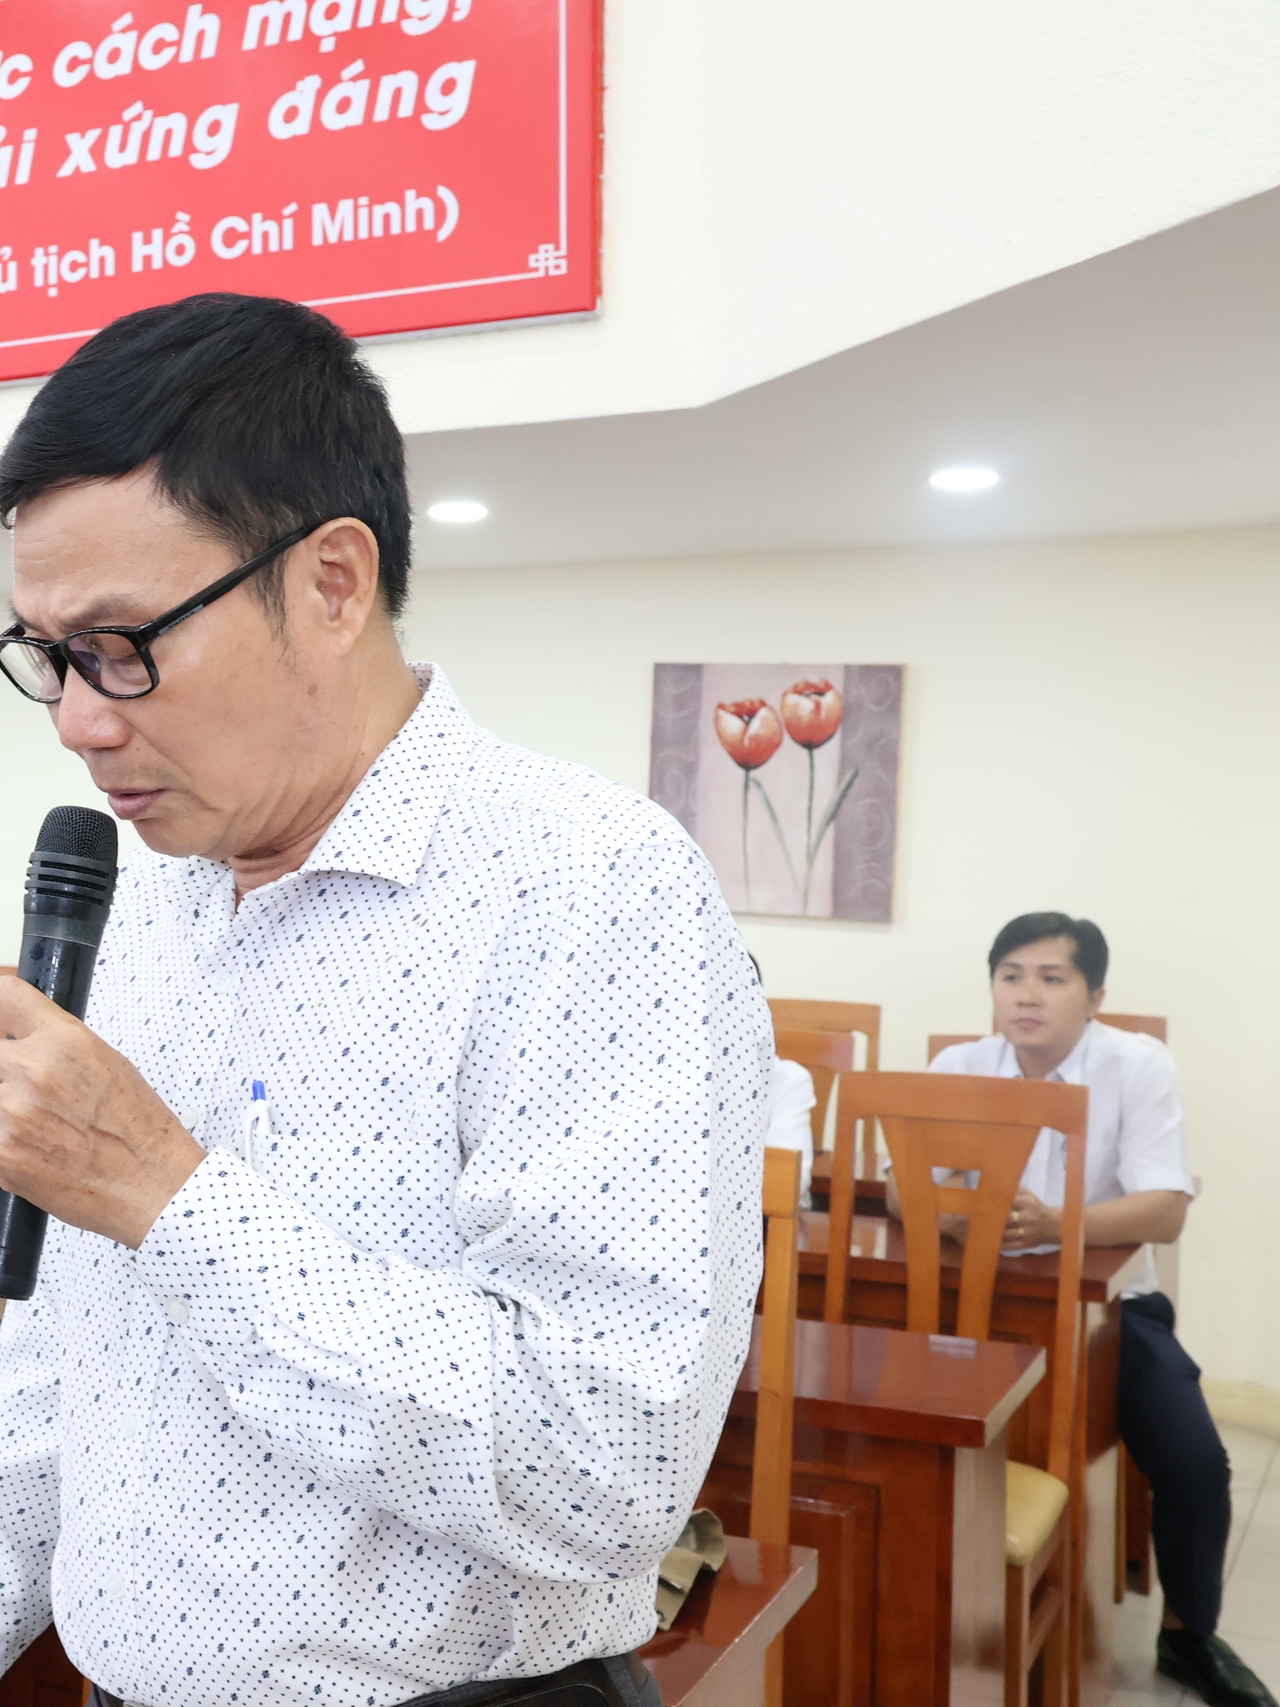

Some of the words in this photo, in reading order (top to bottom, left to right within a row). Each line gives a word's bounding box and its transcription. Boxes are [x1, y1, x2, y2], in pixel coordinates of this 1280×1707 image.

[52, 3, 221, 88] cách
[56, 100, 240, 178] xứng
[267, 59, 477, 140] đáng
[30, 238, 116, 298] tịch
[131, 211, 196, 273] Hồ
[210, 202, 298, 260] Chí
[311, 185, 459, 246] Minh)
